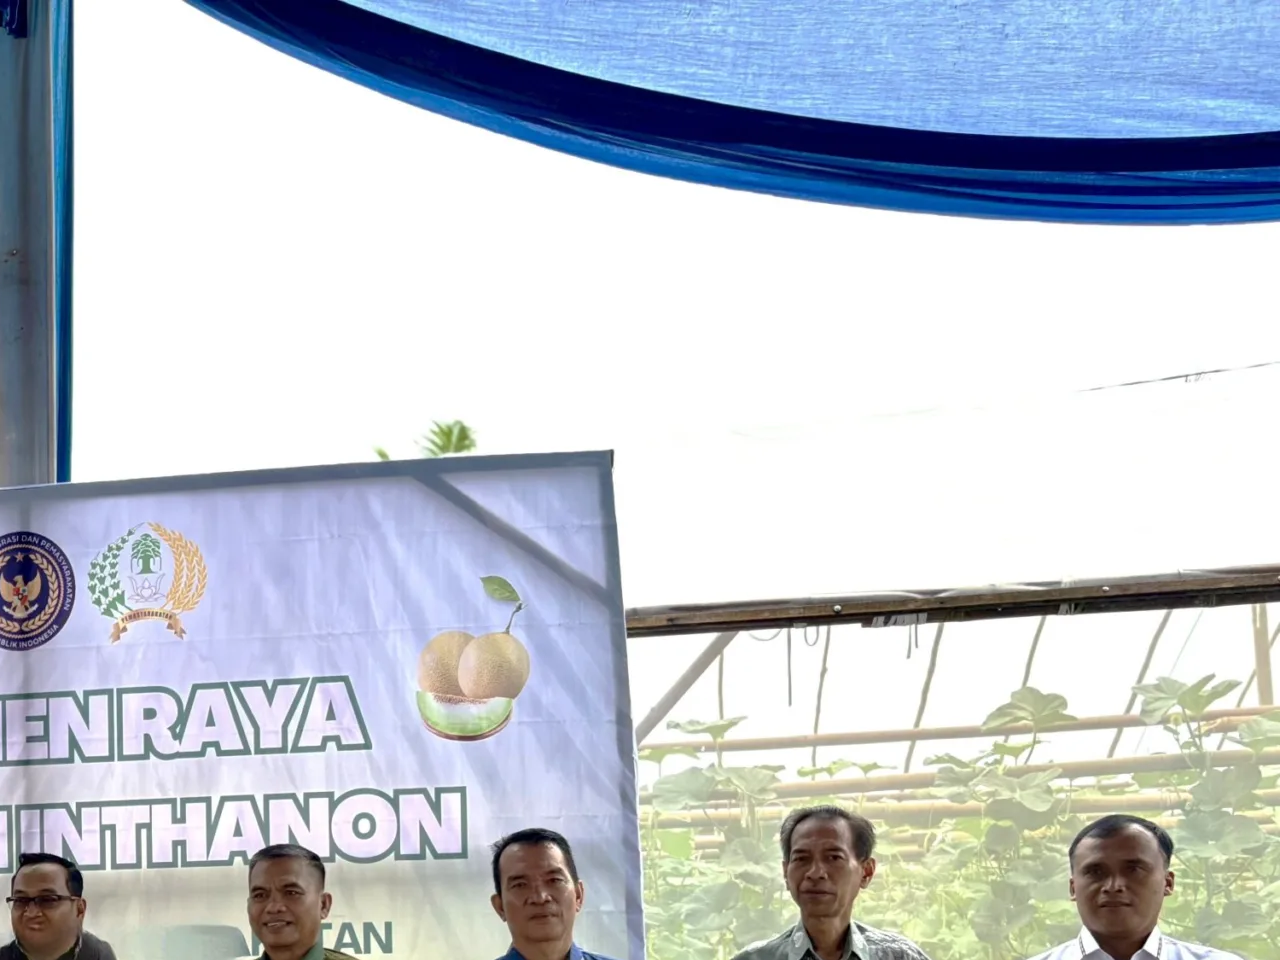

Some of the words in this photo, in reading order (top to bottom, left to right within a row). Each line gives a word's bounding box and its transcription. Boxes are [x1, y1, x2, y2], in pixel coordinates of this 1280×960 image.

[21, 535, 40, 545] DAN
[40, 540, 73, 611] PEMASYARAKATAN
[19, 624, 59, 648] INDONESIA
[119, 675, 373, 761] RAYA
[15, 787, 469, 870] INTHANON
